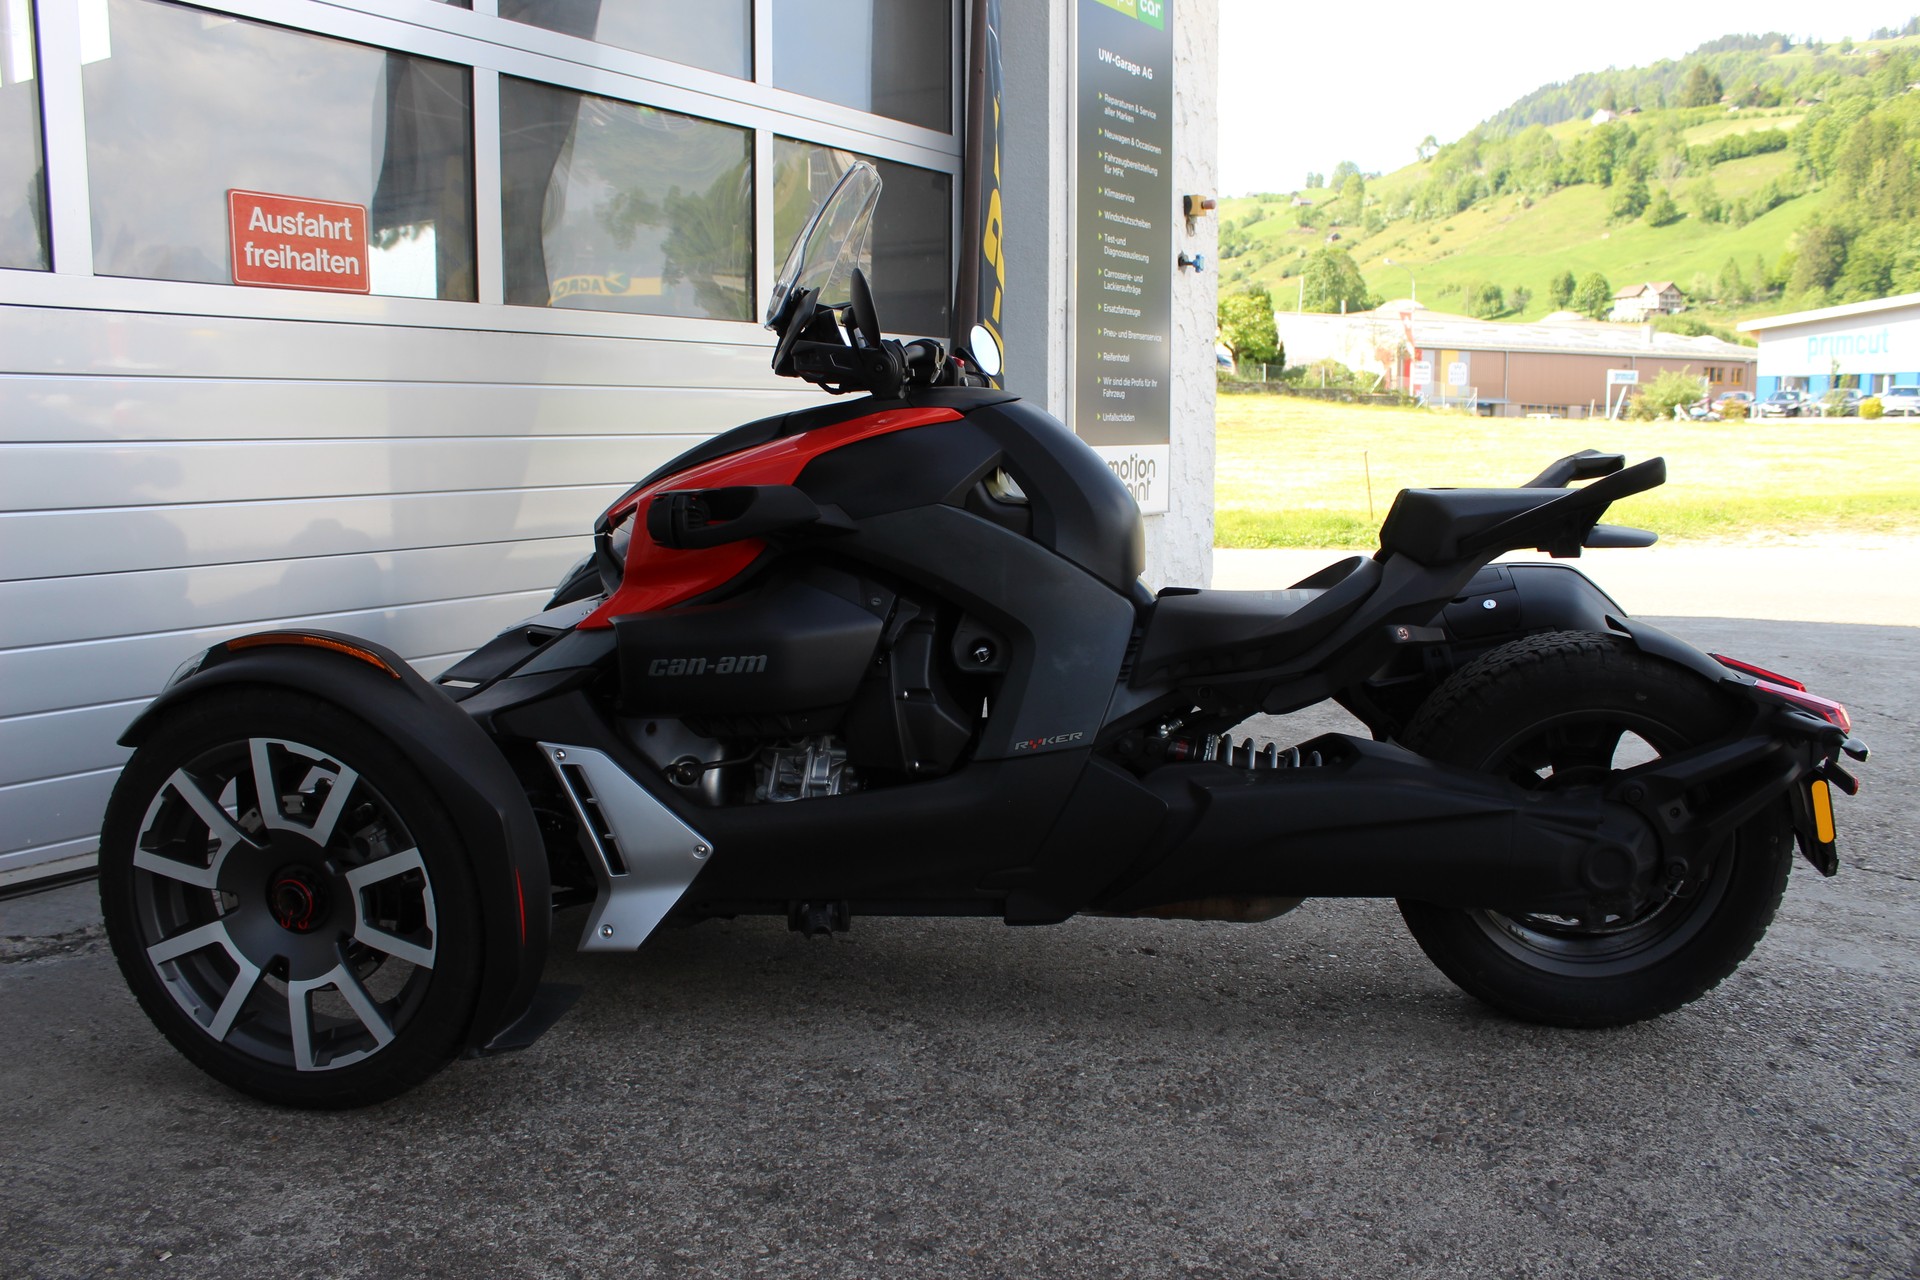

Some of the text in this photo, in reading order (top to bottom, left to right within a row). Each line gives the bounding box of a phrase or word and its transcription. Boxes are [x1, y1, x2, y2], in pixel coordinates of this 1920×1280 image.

[1140, 0, 1161, 18] car
[1098, 48, 1153, 80] UW-Garage AG
[1104, 93, 1157, 120] Reparaturen & Service
[1104, 106, 1135, 124] aller Marken
[1104, 129, 1162, 155] Neuwagen & Occasionen
[1104, 152, 1158, 177] Fahrzeugbereitstellung
[1104, 164, 1125, 178] für MFK
[1104, 187, 1135, 204] Klimaservice
[249, 206, 353, 241] Ausfahrt
[1104, 210, 1151, 229] Windschutzscheiben
[244, 241, 359, 275] freihalten
[1104, 245, 1149, 264] Diagnoseauslesung
[1104, 268, 1143, 283] Carrosserie- und
[1103, 281, 1141, 296] Lackieraufträge
[1103, 303, 1141, 318] Ersatzfahrzeuge
[1103, 327, 1162, 343] Pneu- und Bremsenservice
[1807, 325, 1889, 364] primcut
[1103, 352, 1130, 363] Reifenhotel
[1103, 376, 1111, 385] Wir
[1112, 377, 1123, 386] sind
[1130, 378, 1144, 387] Profis
[1103, 388, 1125, 400] Fahrzeug
[1102, 412, 1135, 422] Unfallschäden
[648, 654, 768, 677] can-am
[1014, 731, 1083, 751] RYKER
